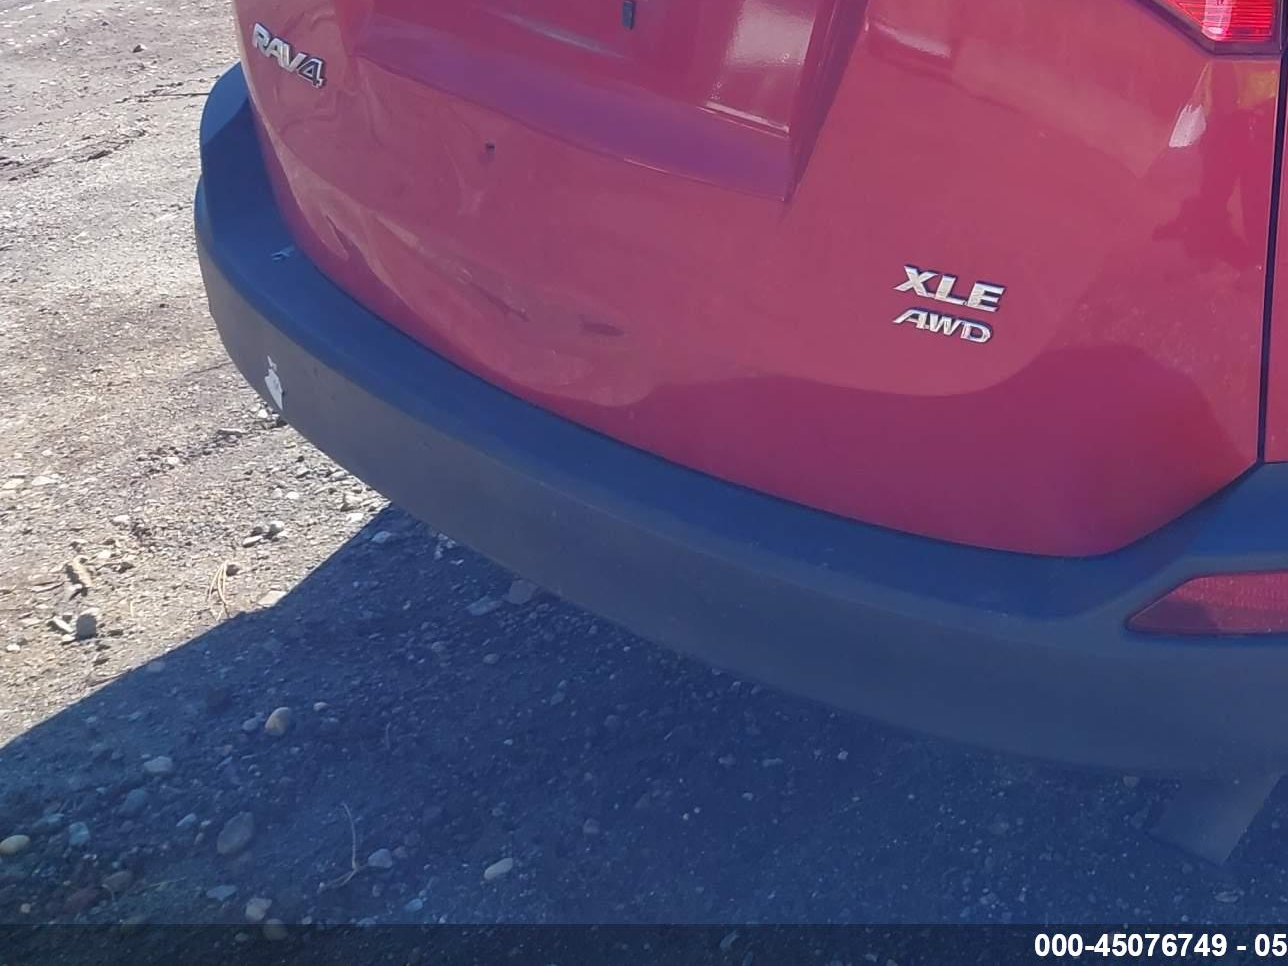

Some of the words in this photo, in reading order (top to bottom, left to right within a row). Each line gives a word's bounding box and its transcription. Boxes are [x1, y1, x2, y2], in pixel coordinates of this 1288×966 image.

[251, 22, 325, 89] RAV4
[893, 264, 1006, 313] XLE
[892, 306, 993, 344] AWD
